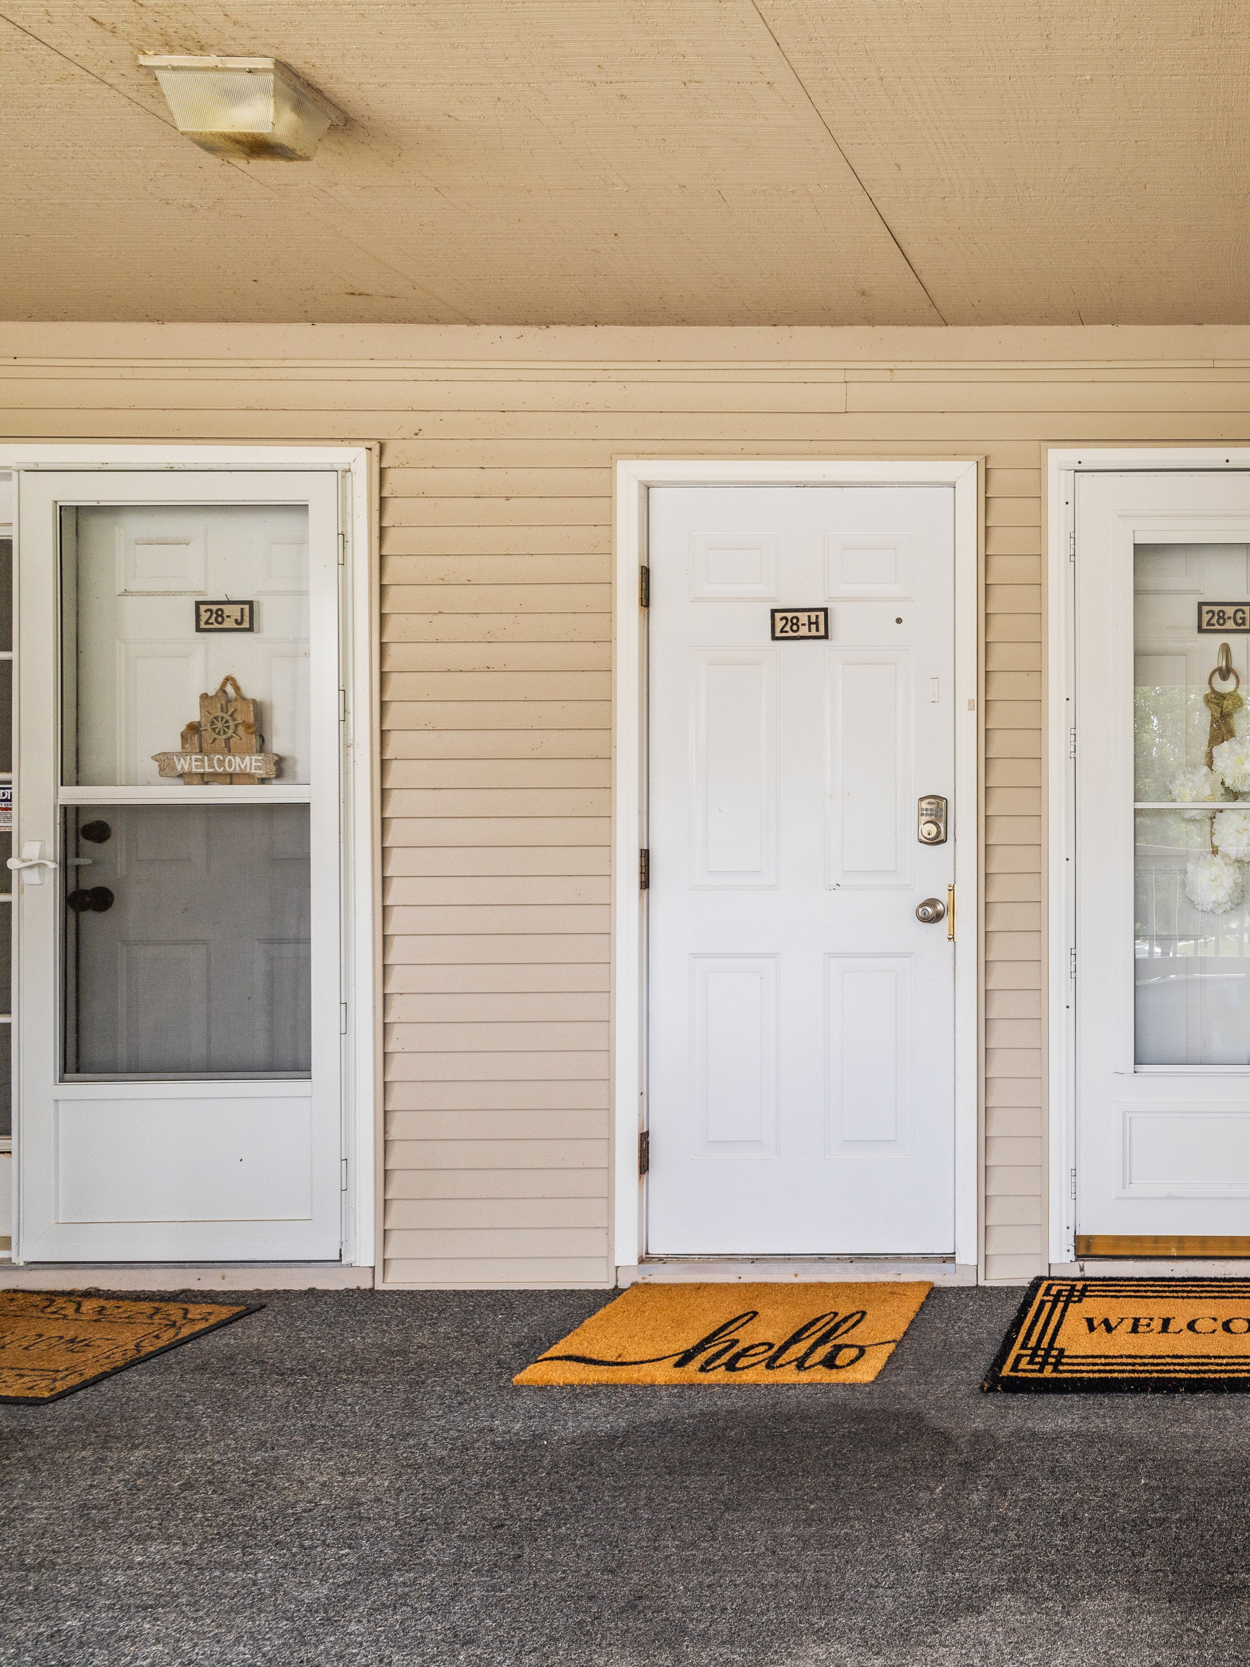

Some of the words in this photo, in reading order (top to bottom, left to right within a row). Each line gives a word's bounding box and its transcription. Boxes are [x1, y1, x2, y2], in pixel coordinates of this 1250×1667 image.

[203, 607, 245, 626] 28-J
[779, 614, 820, 634] 28-H
[1205, 608, 1247, 627] 28-G
[173, 755, 264, 773] WELCOME
[0, 789, 12, 800] DT
[532, 1310, 898, 1373] hello
